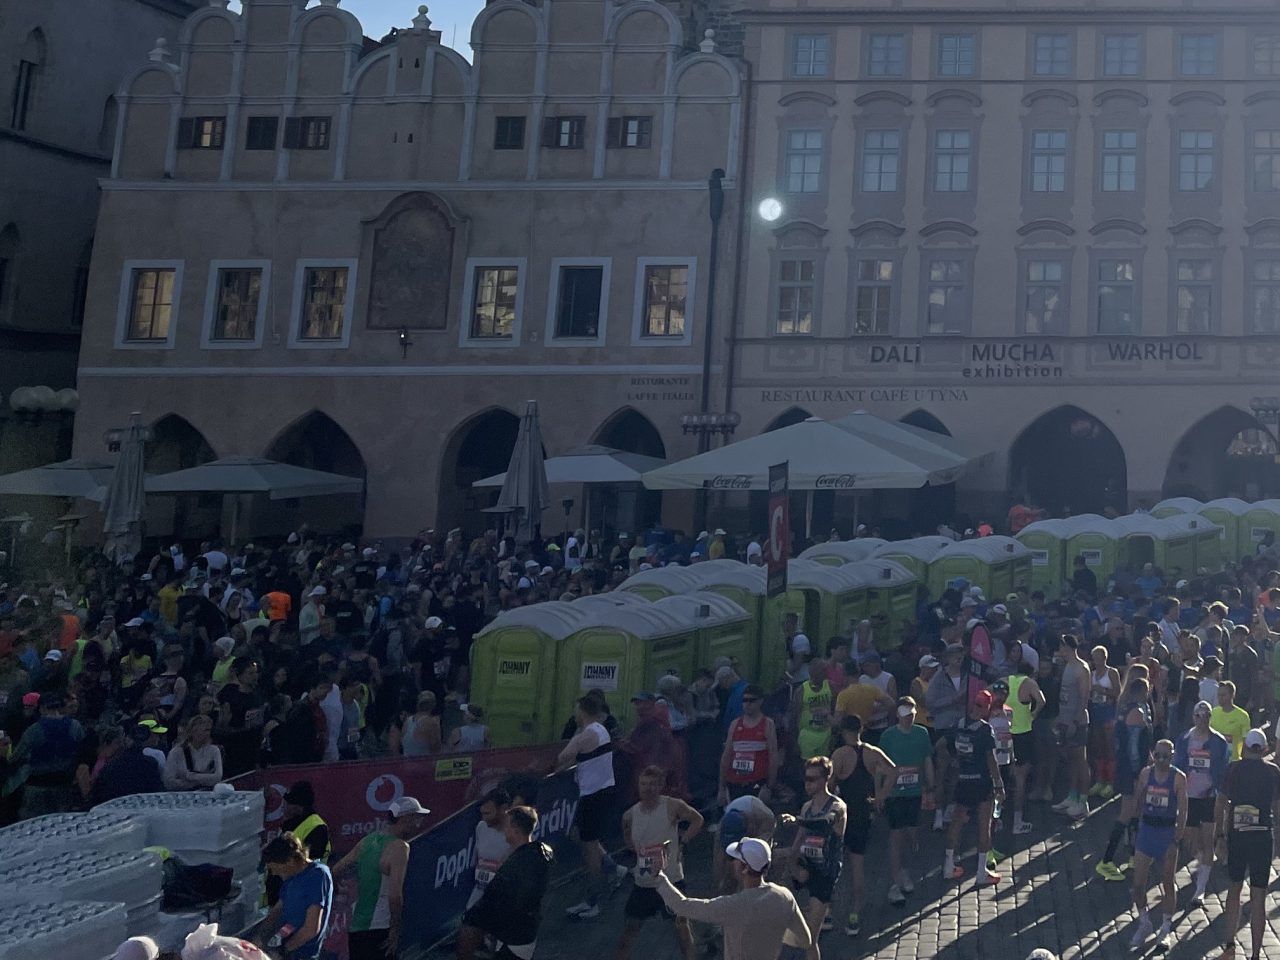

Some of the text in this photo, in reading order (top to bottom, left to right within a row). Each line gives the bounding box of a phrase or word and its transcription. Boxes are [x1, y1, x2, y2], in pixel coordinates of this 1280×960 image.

[972, 343, 1055, 361] MUCHA
[1107, 342, 1203, 360] WARHOL
[962, 364, 1063, 378] exhibition
[630, 377, 690, 386] RISTORANTE
[662, 392, 695, 401] ITALIA
[760, 390, 866, 403] RESTAURANT
[914, 389, 925, 402] U
[815, 473, 857, 488] Coca-Cola
[771, 504, 784, 562] C
[498, 660, 531, 675] JOHNNY
[583, 665, 617, 680] JOHNNY
